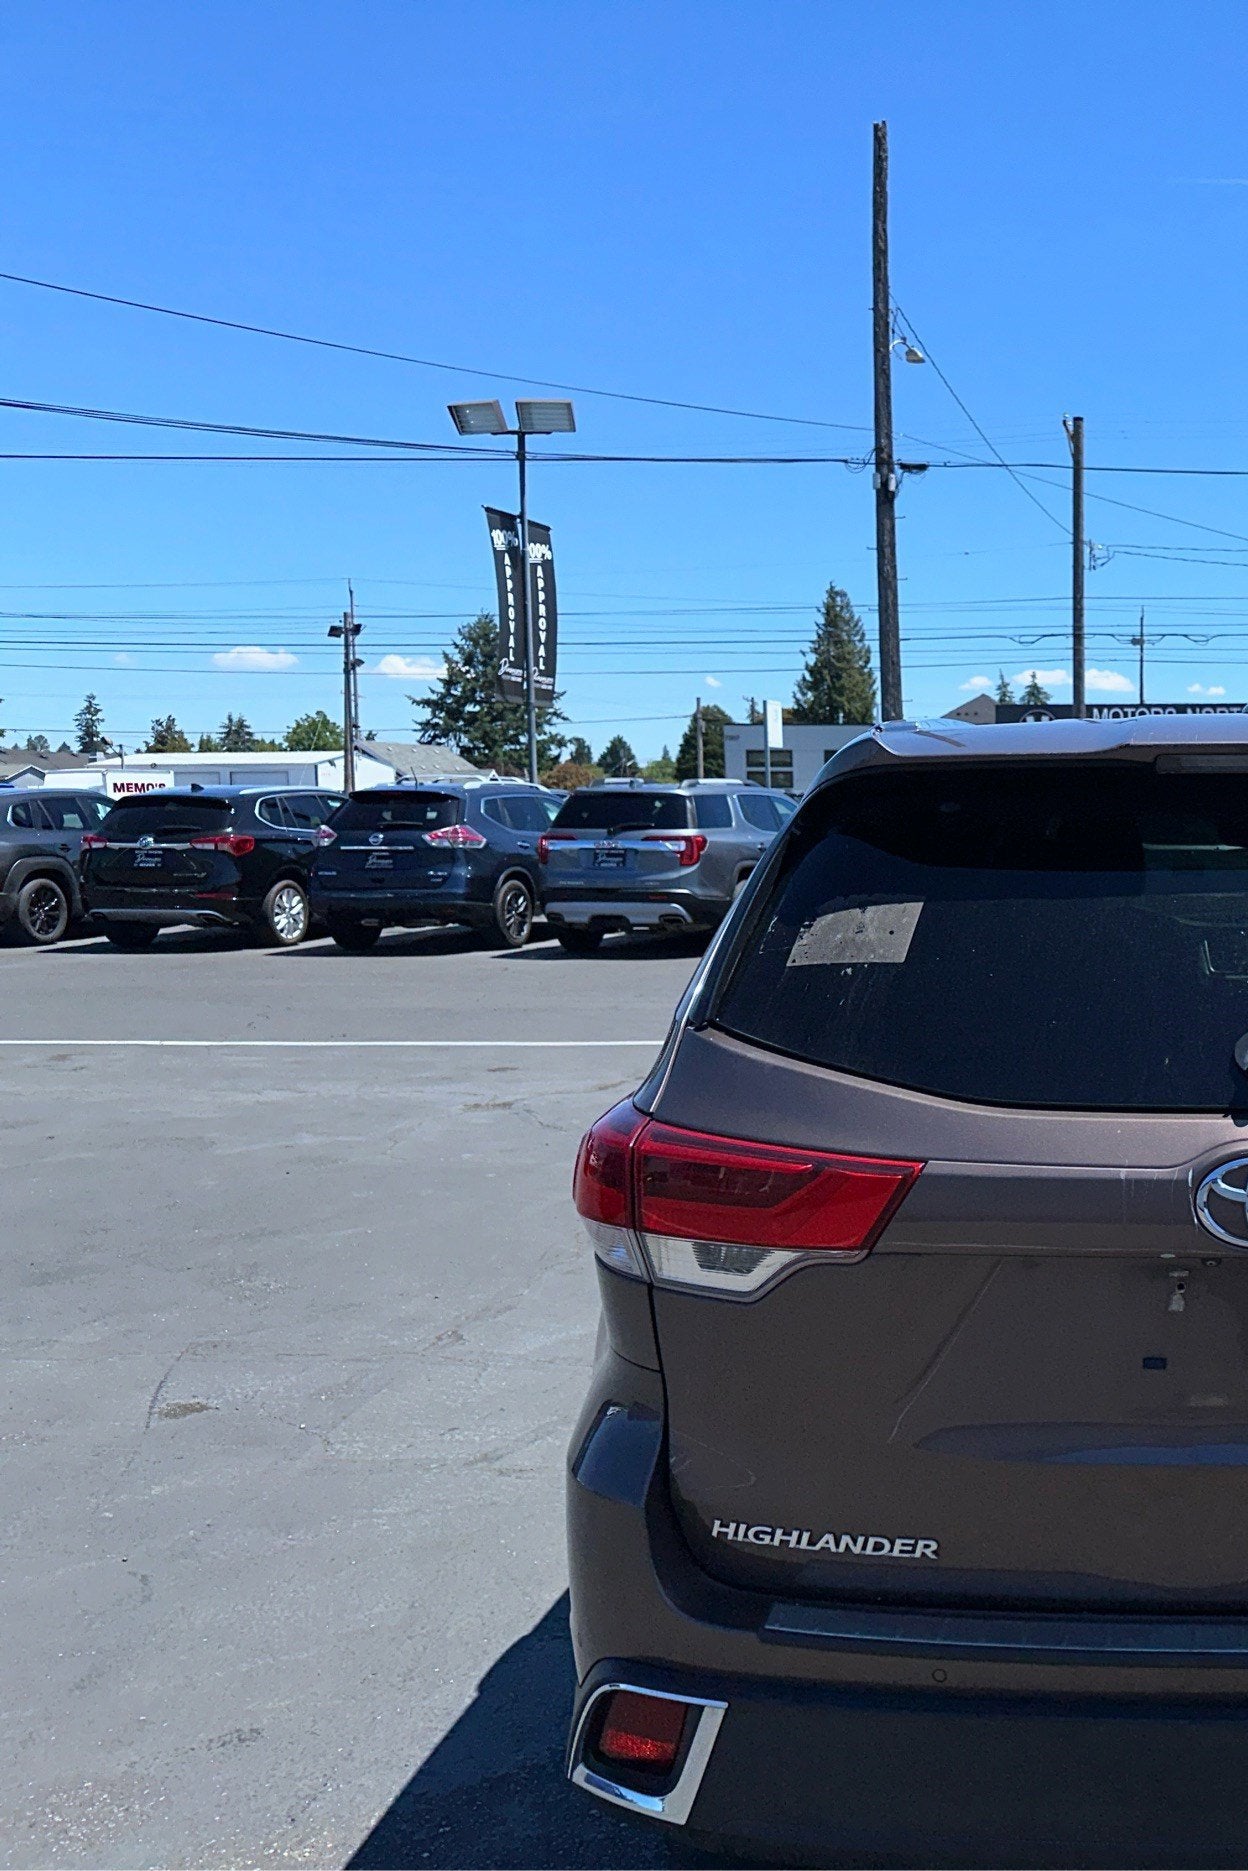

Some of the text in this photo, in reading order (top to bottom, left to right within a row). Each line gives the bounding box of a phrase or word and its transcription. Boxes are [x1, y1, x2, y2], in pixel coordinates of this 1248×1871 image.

[491, 529, 518, 547] 100%
[504, 552, 515, 661] APPROVAL
[536, 565, 546, 670] APPROVAL
[711, 1519, 939, 1560] HIGHLANDER
